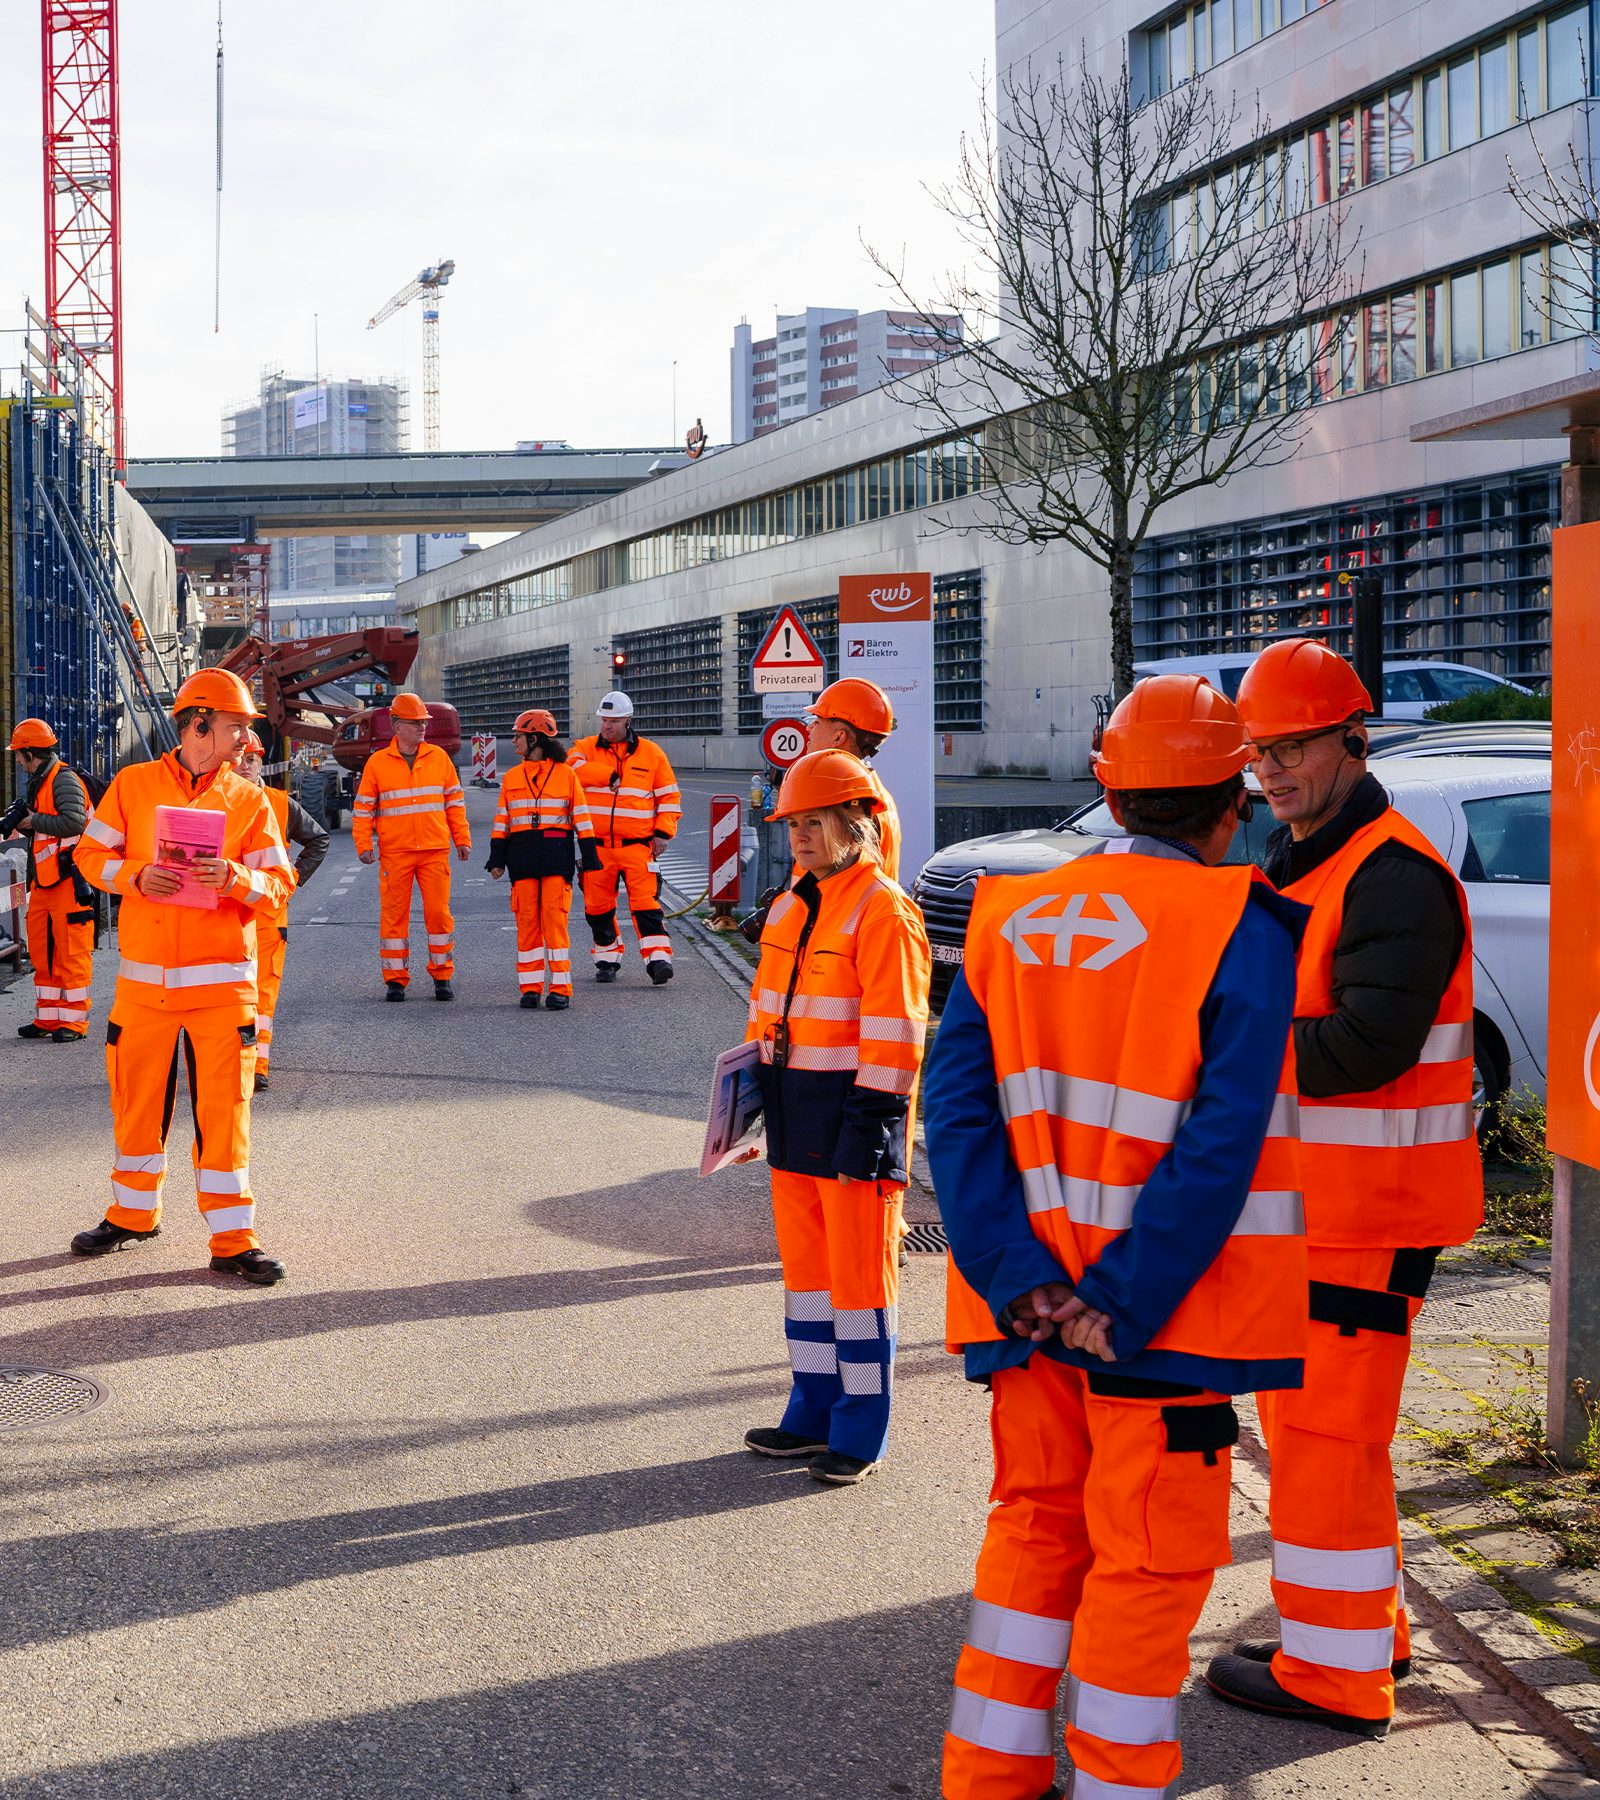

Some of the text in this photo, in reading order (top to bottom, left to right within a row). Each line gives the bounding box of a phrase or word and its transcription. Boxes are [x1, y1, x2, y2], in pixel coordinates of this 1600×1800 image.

[867, 582, 913, 606] ewb
[866, 639, 893, 647] Bären
[866, 649, 898, 657] Elektro
[760, 673, 817, 684] Privatareal
[777, 734, 797, 751] 20
